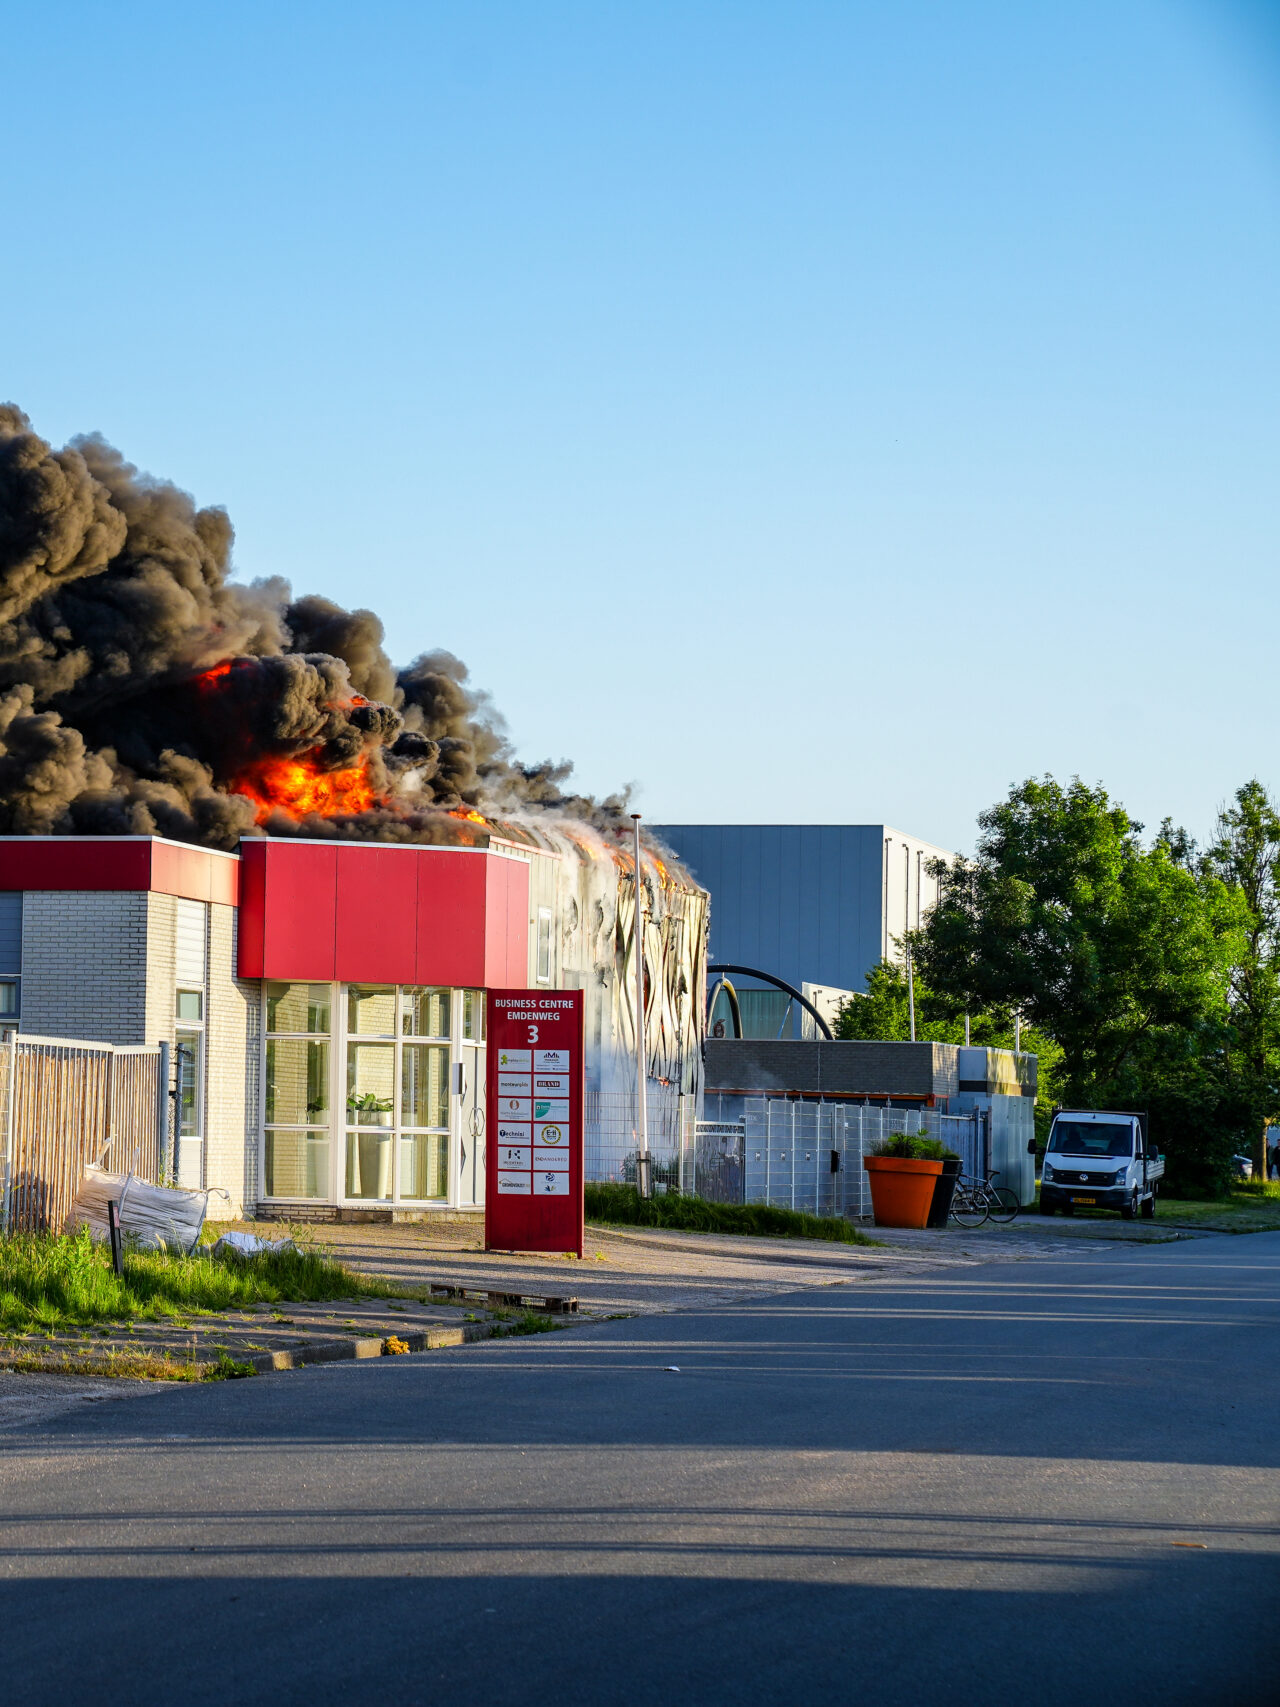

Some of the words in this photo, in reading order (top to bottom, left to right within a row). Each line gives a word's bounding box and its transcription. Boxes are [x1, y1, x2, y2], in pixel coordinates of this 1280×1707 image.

[495, 999, 536, 1008] BUSINESS
[539, 1000, 574, 1008] CENTRE
[507, 1012, 560, 1020] EMDENWEG
[527, 1025, 539, 1044] 3
